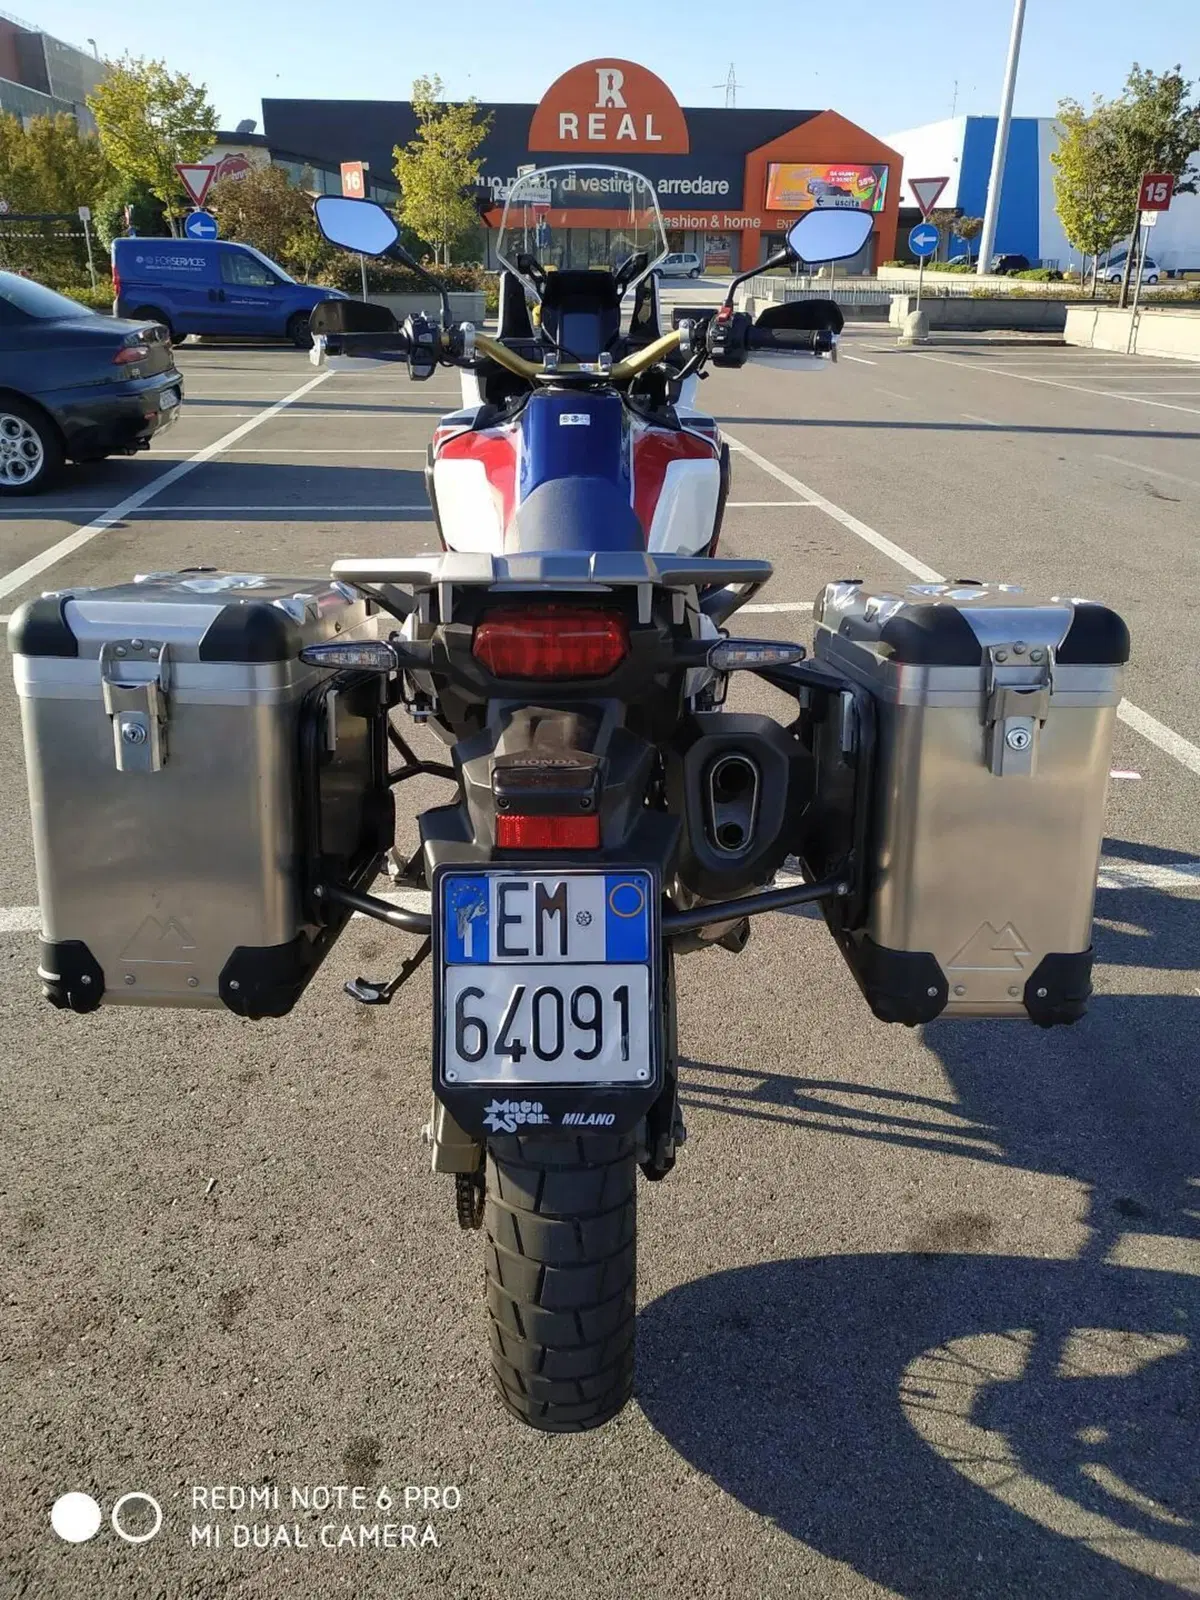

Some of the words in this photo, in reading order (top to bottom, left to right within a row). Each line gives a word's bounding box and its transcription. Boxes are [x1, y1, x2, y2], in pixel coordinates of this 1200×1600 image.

[559, 112, 662, 141] REAL
[345, 171, 360, 190] 16
[507, 172, 557, 190] modo
[562, 170, 576, 191] di
[580, 172, 632, 193] vestire
[658, 175, 729, 194] arredare
[1145, 182, 1168, 202] 15
[835, 199, 859, 207] uscita
[710, 214, 720, 228] &
[724, 214, 761, 229] home
[496, 881, 568, 956] EM
[455, 985, 629, 1063] 64091
[561, 1112, 616, 1126] MILANO
